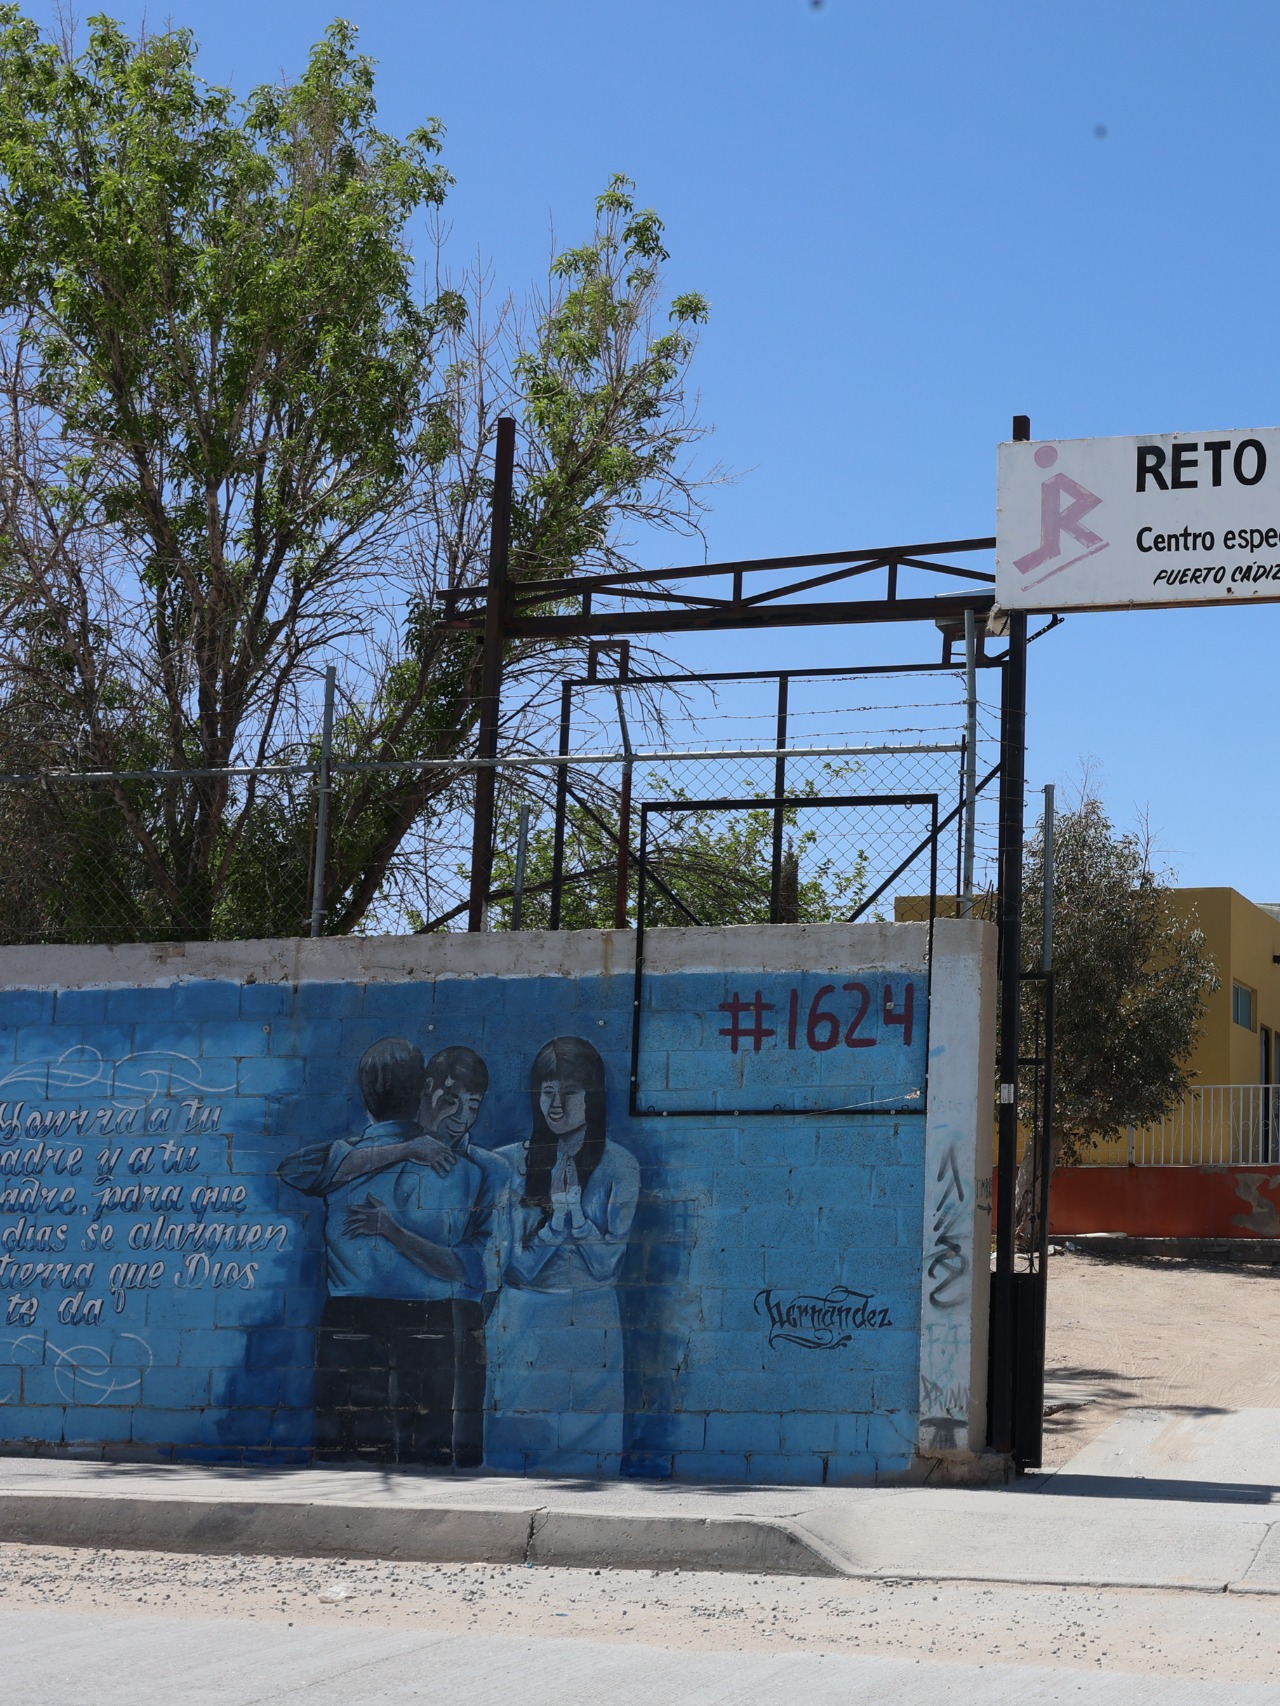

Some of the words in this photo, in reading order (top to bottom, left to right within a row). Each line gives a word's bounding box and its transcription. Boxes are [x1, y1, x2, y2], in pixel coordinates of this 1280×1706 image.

[1136, 438, 1266, 492] RETO
[1137, 526, 1214, 552] Centro
[1153, 566, 1226, 585] PUERTO
[718, 981, 915, 1054] #1624
[151, 1106, 171, 1133] a
[180, 1100, 222, 1133] tu
[0, 1141, 83, 1176] adre
[94, 1144, 124, 1186] y
[128, 1144, 155, 1175] a
[159, 1139, 200, 1174] tu
[92, 1185, 184, 1221] para
[189, 1184, 248, 1224] que
[81, 1222, 116, 1251] se
[128, 1215, 288, 1257] alarguen
[109, 1259, 165, 1315] que
[173, 1252, 260, 1290] Dios
[6, 1293, 39, 1328] te
[57, 1290, 105, 1327] da
